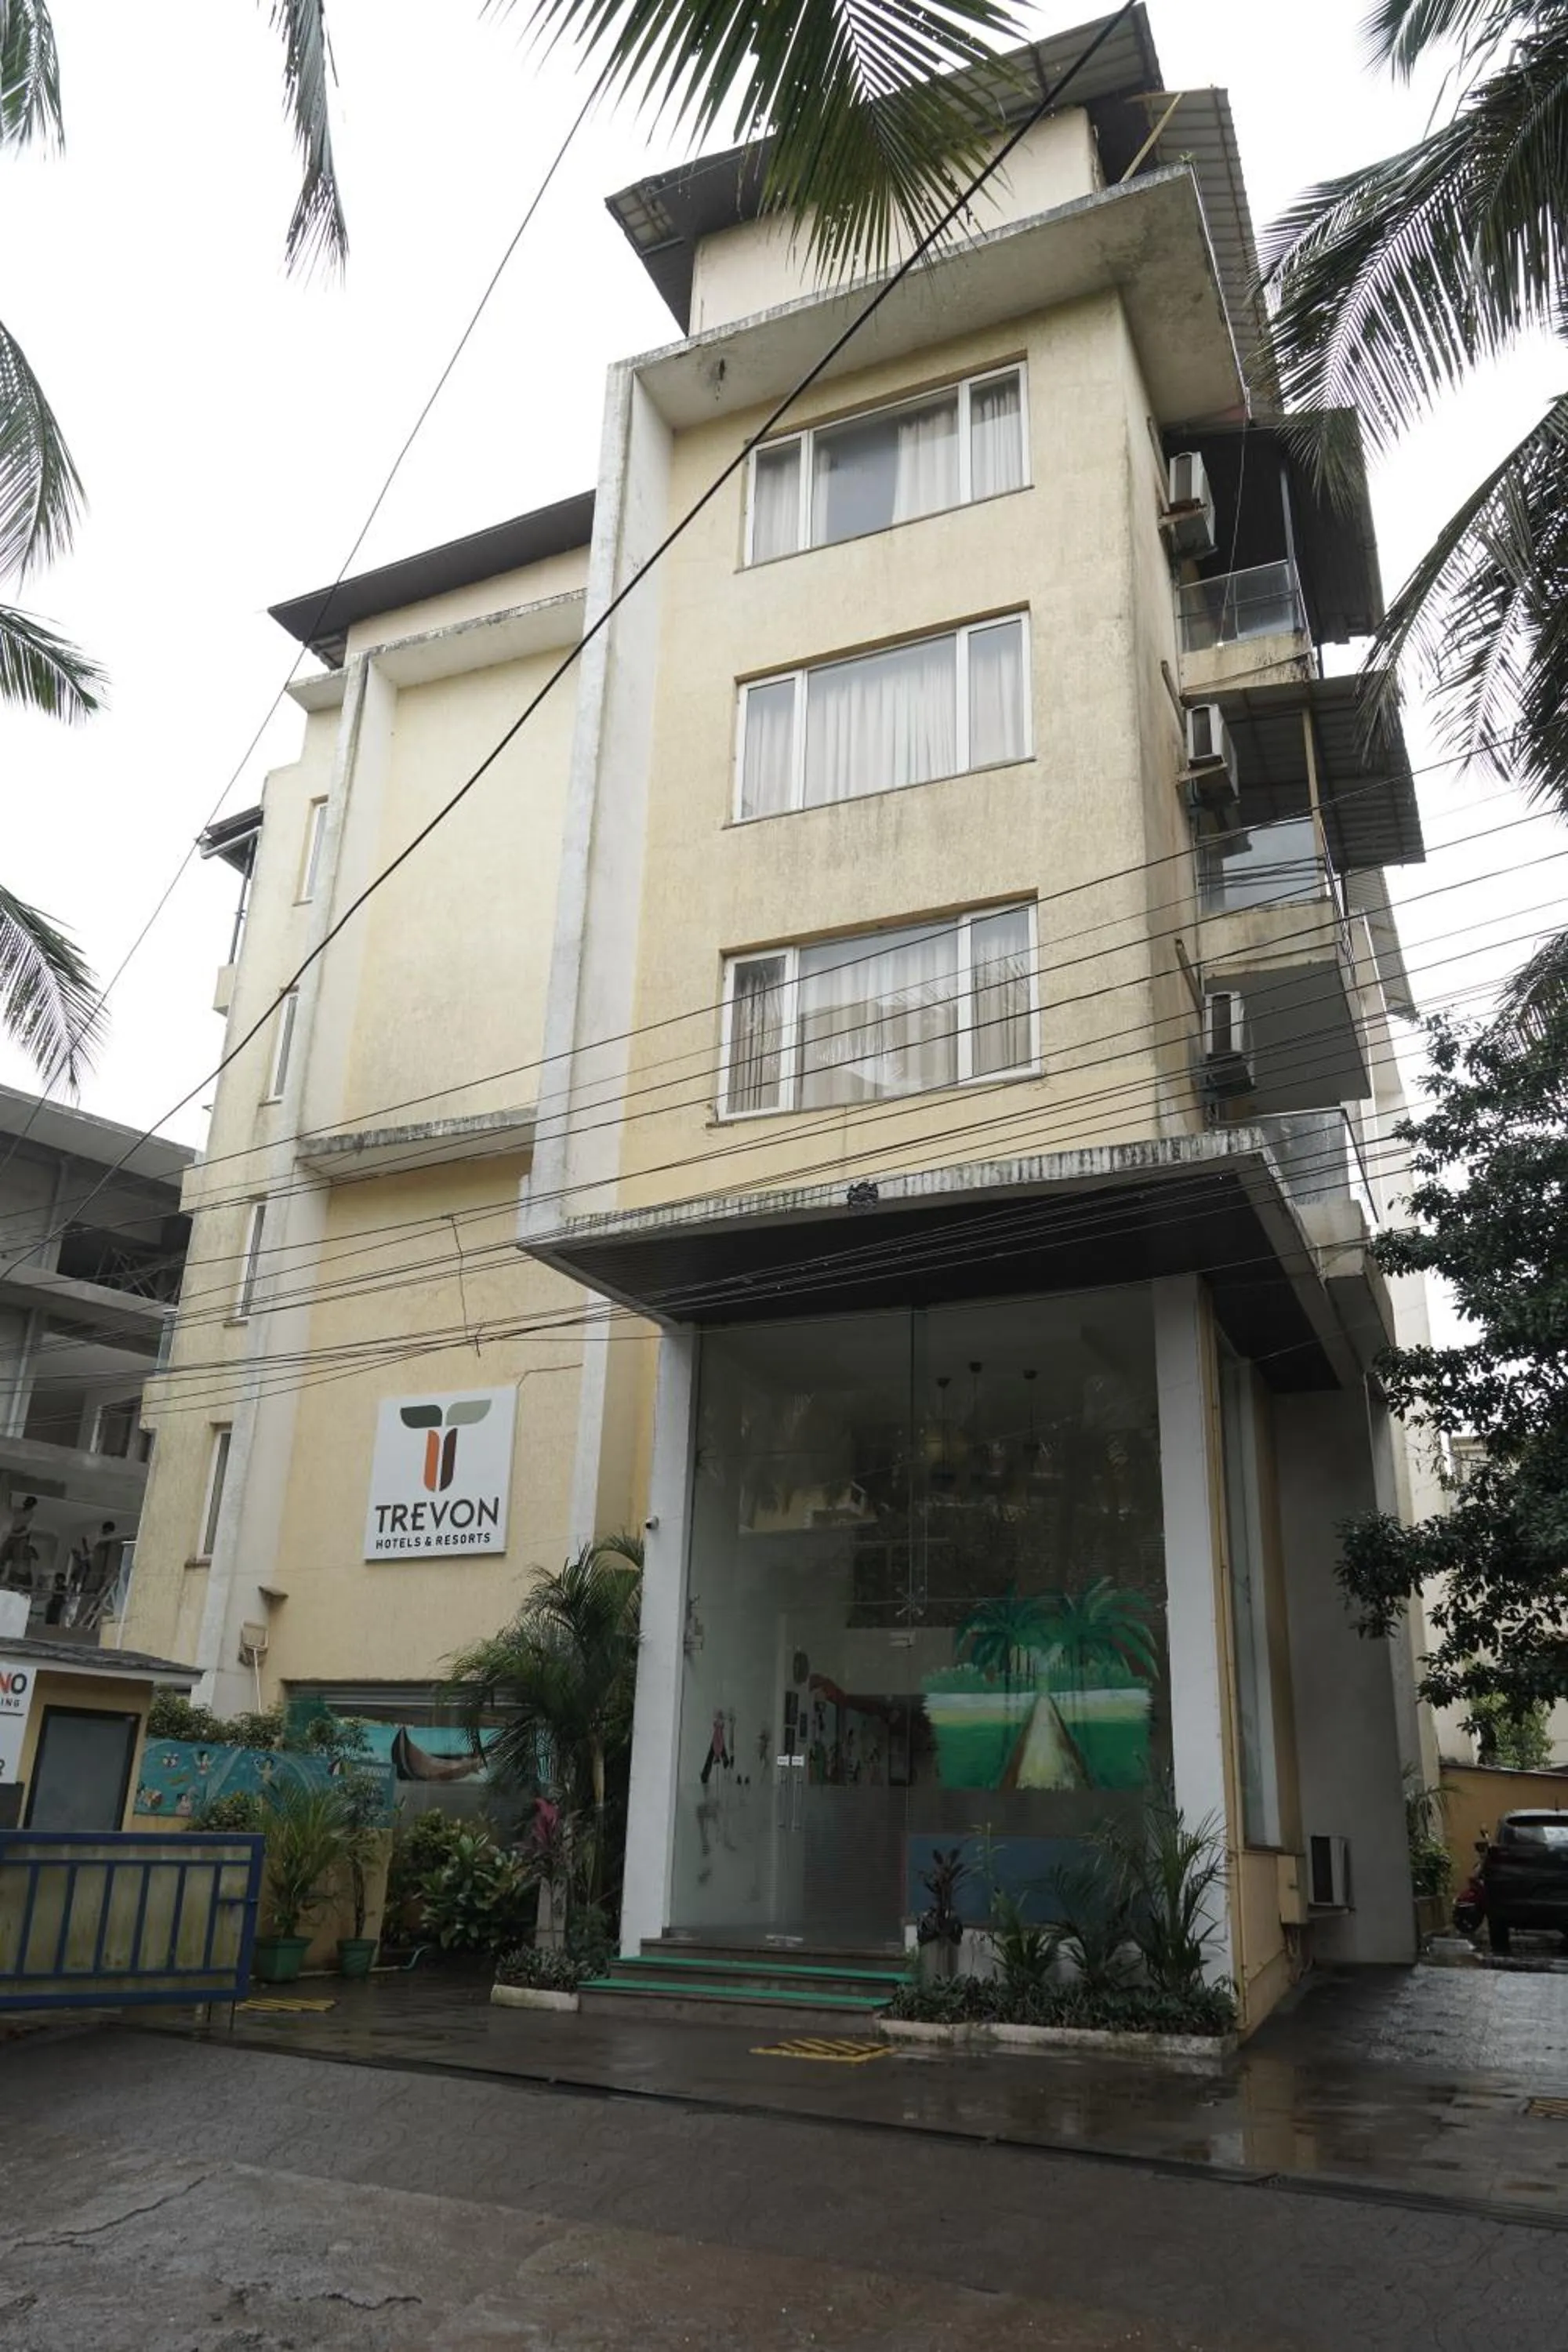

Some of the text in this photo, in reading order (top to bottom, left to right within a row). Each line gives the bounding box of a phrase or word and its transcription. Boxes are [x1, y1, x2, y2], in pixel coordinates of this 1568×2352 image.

[375, 1497, 499, 1534] TREVON
[376, 1532, 491, 1550] HOTELS & RESORTS
